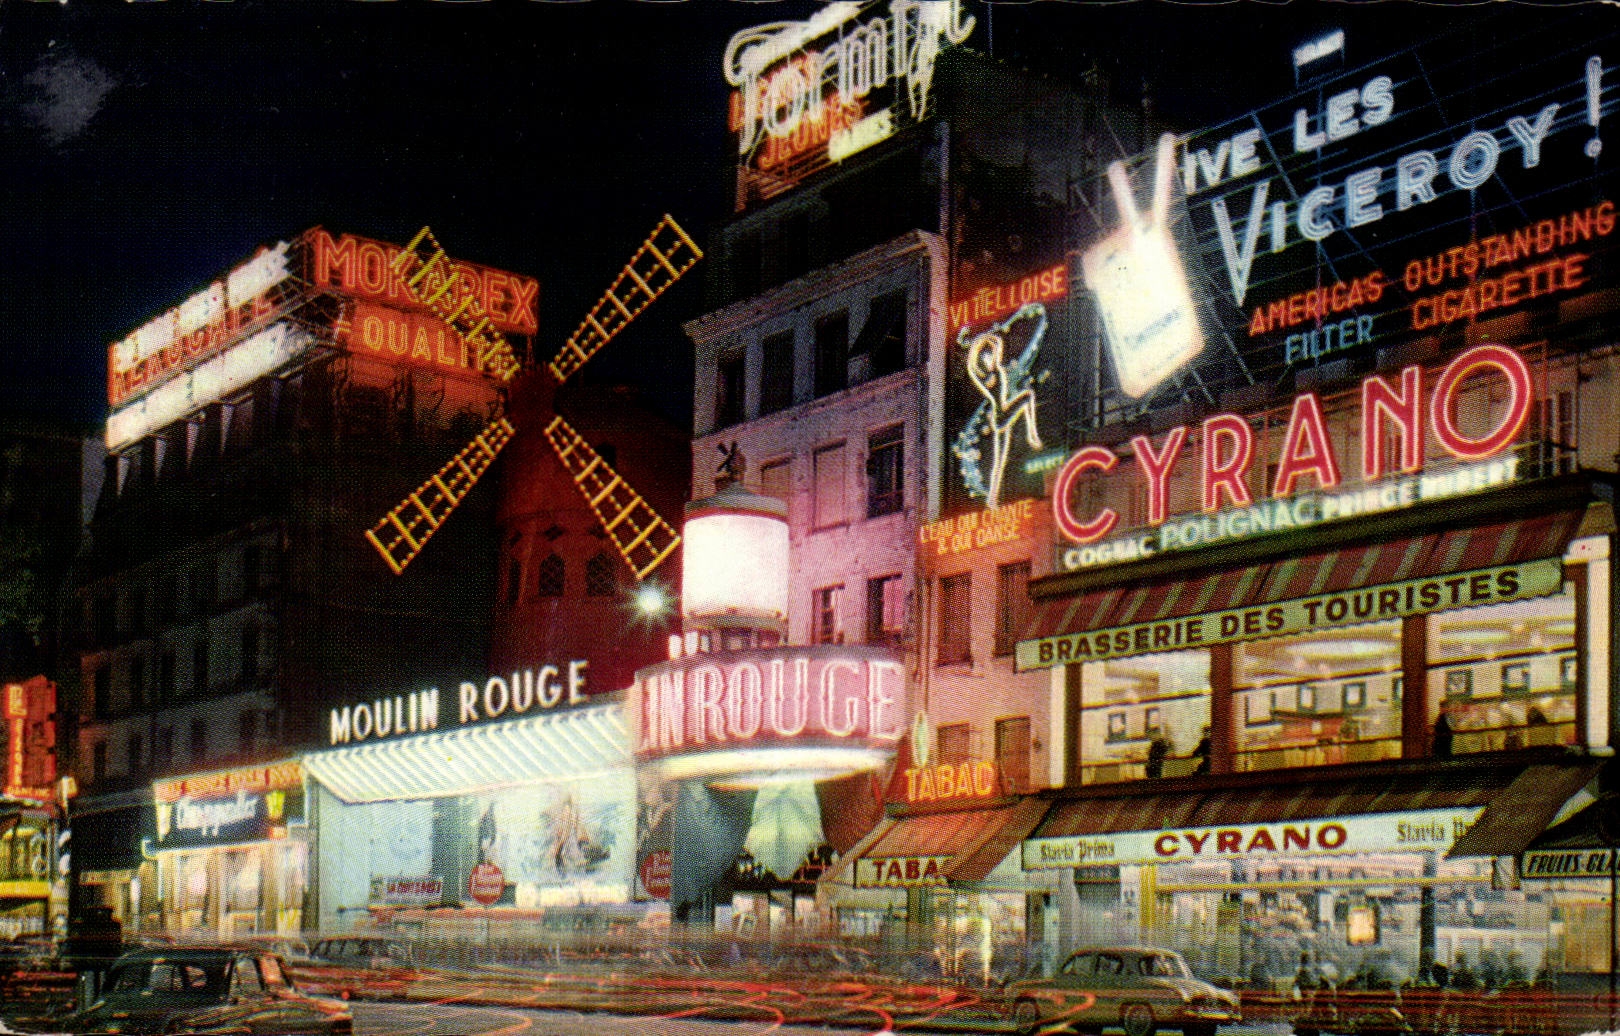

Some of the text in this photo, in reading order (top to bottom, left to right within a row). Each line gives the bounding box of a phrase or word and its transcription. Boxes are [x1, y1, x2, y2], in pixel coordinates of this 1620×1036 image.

[1294, 75, 1395, 153] LES
[317, 231, 538, 329] MOKAREX
[1405, 200, 1615, 291] OUTSTANDING
[1285, 254, 1592, 365] FILTER CIGARETTE
[1052, 344, 1533, 544] CYRANO
[976, 519, 1020, 547] DANSE
[1064, 534, 1154, 569] COGNAC
[1160, 496, 1320, 550] POLIGNAC
[1323, 482, 1414, 520] PRINCE
[1038, 570, 1519, 663] BRASSERIE DES TOURISTES
[330, 660, 590, 745] MOULIN ROUGE
[694, 658, 904, 744] ROUGE
[904, 761, 994, 802] TABAC
[872, 859, 942, 882] TABA
[1154, 821, 1348, 857] CYRANO
